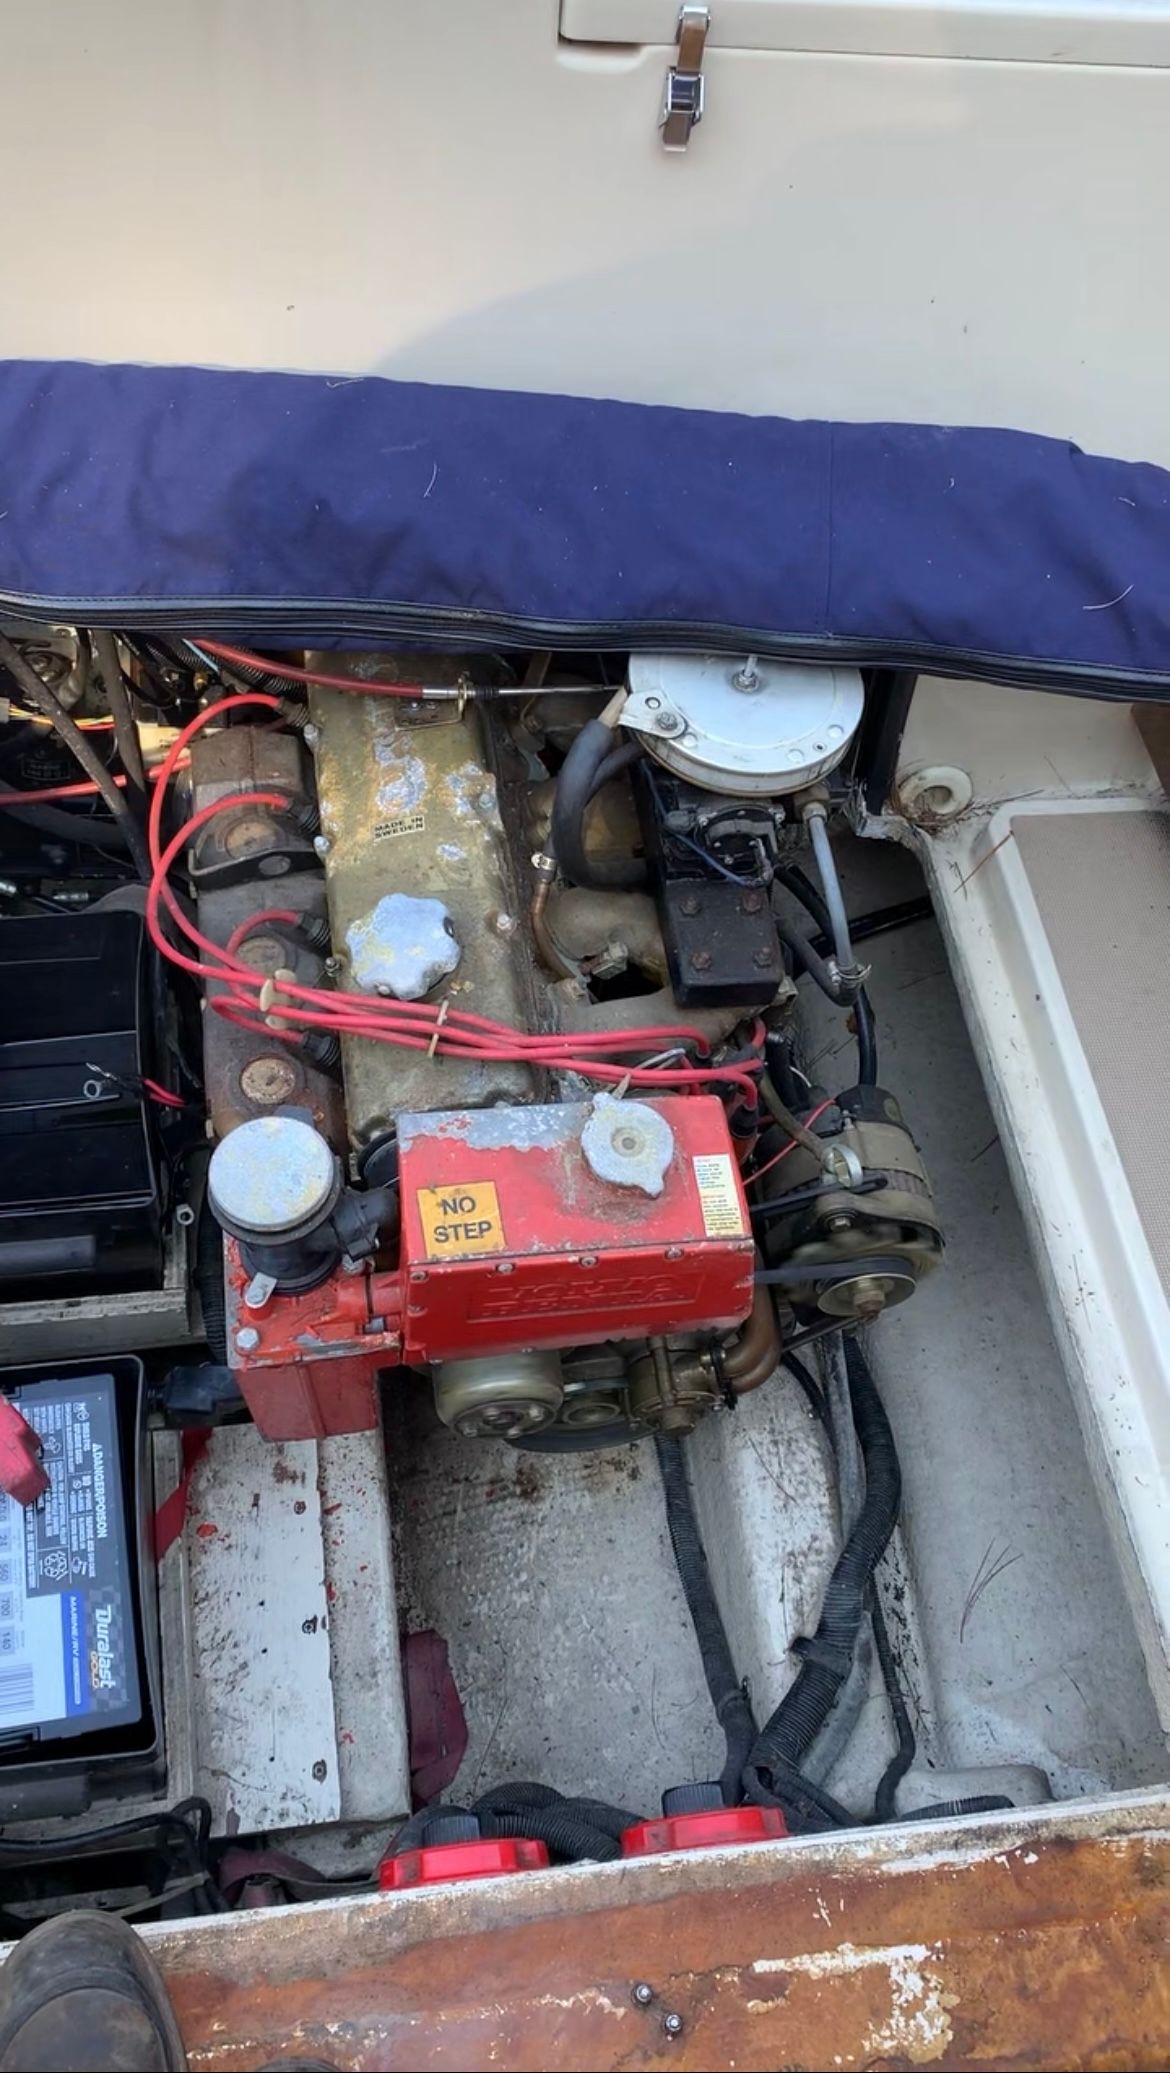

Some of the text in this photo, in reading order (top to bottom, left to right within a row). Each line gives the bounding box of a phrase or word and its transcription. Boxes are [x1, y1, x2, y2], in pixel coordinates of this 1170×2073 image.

[375, 820, 402, 831] MADE
[375, 823, 423, 838] SWEDEN
[442, 1195, 476, 1216] NO
[433, 1220, 492, 1244] STEP
[96, 1604, 116, 1689] Duralast
[90, 1650, 100, 1689] GOLD
